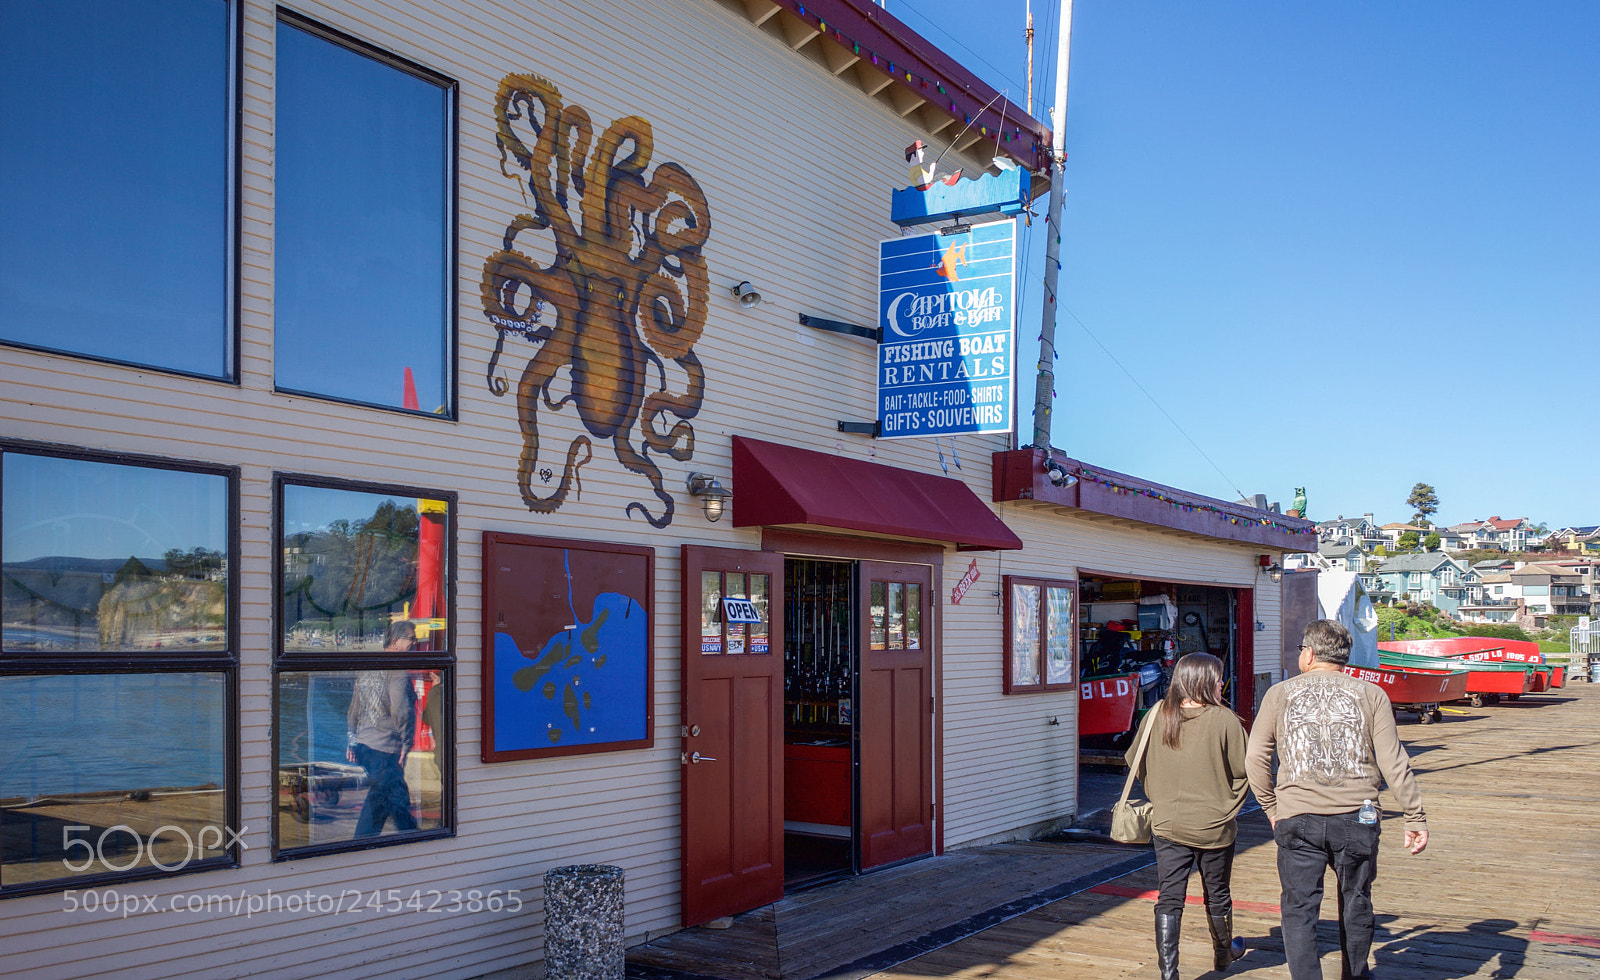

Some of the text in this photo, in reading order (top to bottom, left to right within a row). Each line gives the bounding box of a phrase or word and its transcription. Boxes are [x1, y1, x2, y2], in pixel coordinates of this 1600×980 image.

[887, 287, 1003, 337] CAPITOLA
[912, 306, 1004, 331] BOAT & BAIT
[884, 334, 1005, 364] FISHING BOAT
[884, 356, 1005, 385] RENTALS
[885, 385, 1003, 411] BAIT TACKLE FOOD SHIRTS
[885, 404, 1003, 431] GIFTS SOUVENIRS
[727, 602, 759, 620] OPEN
